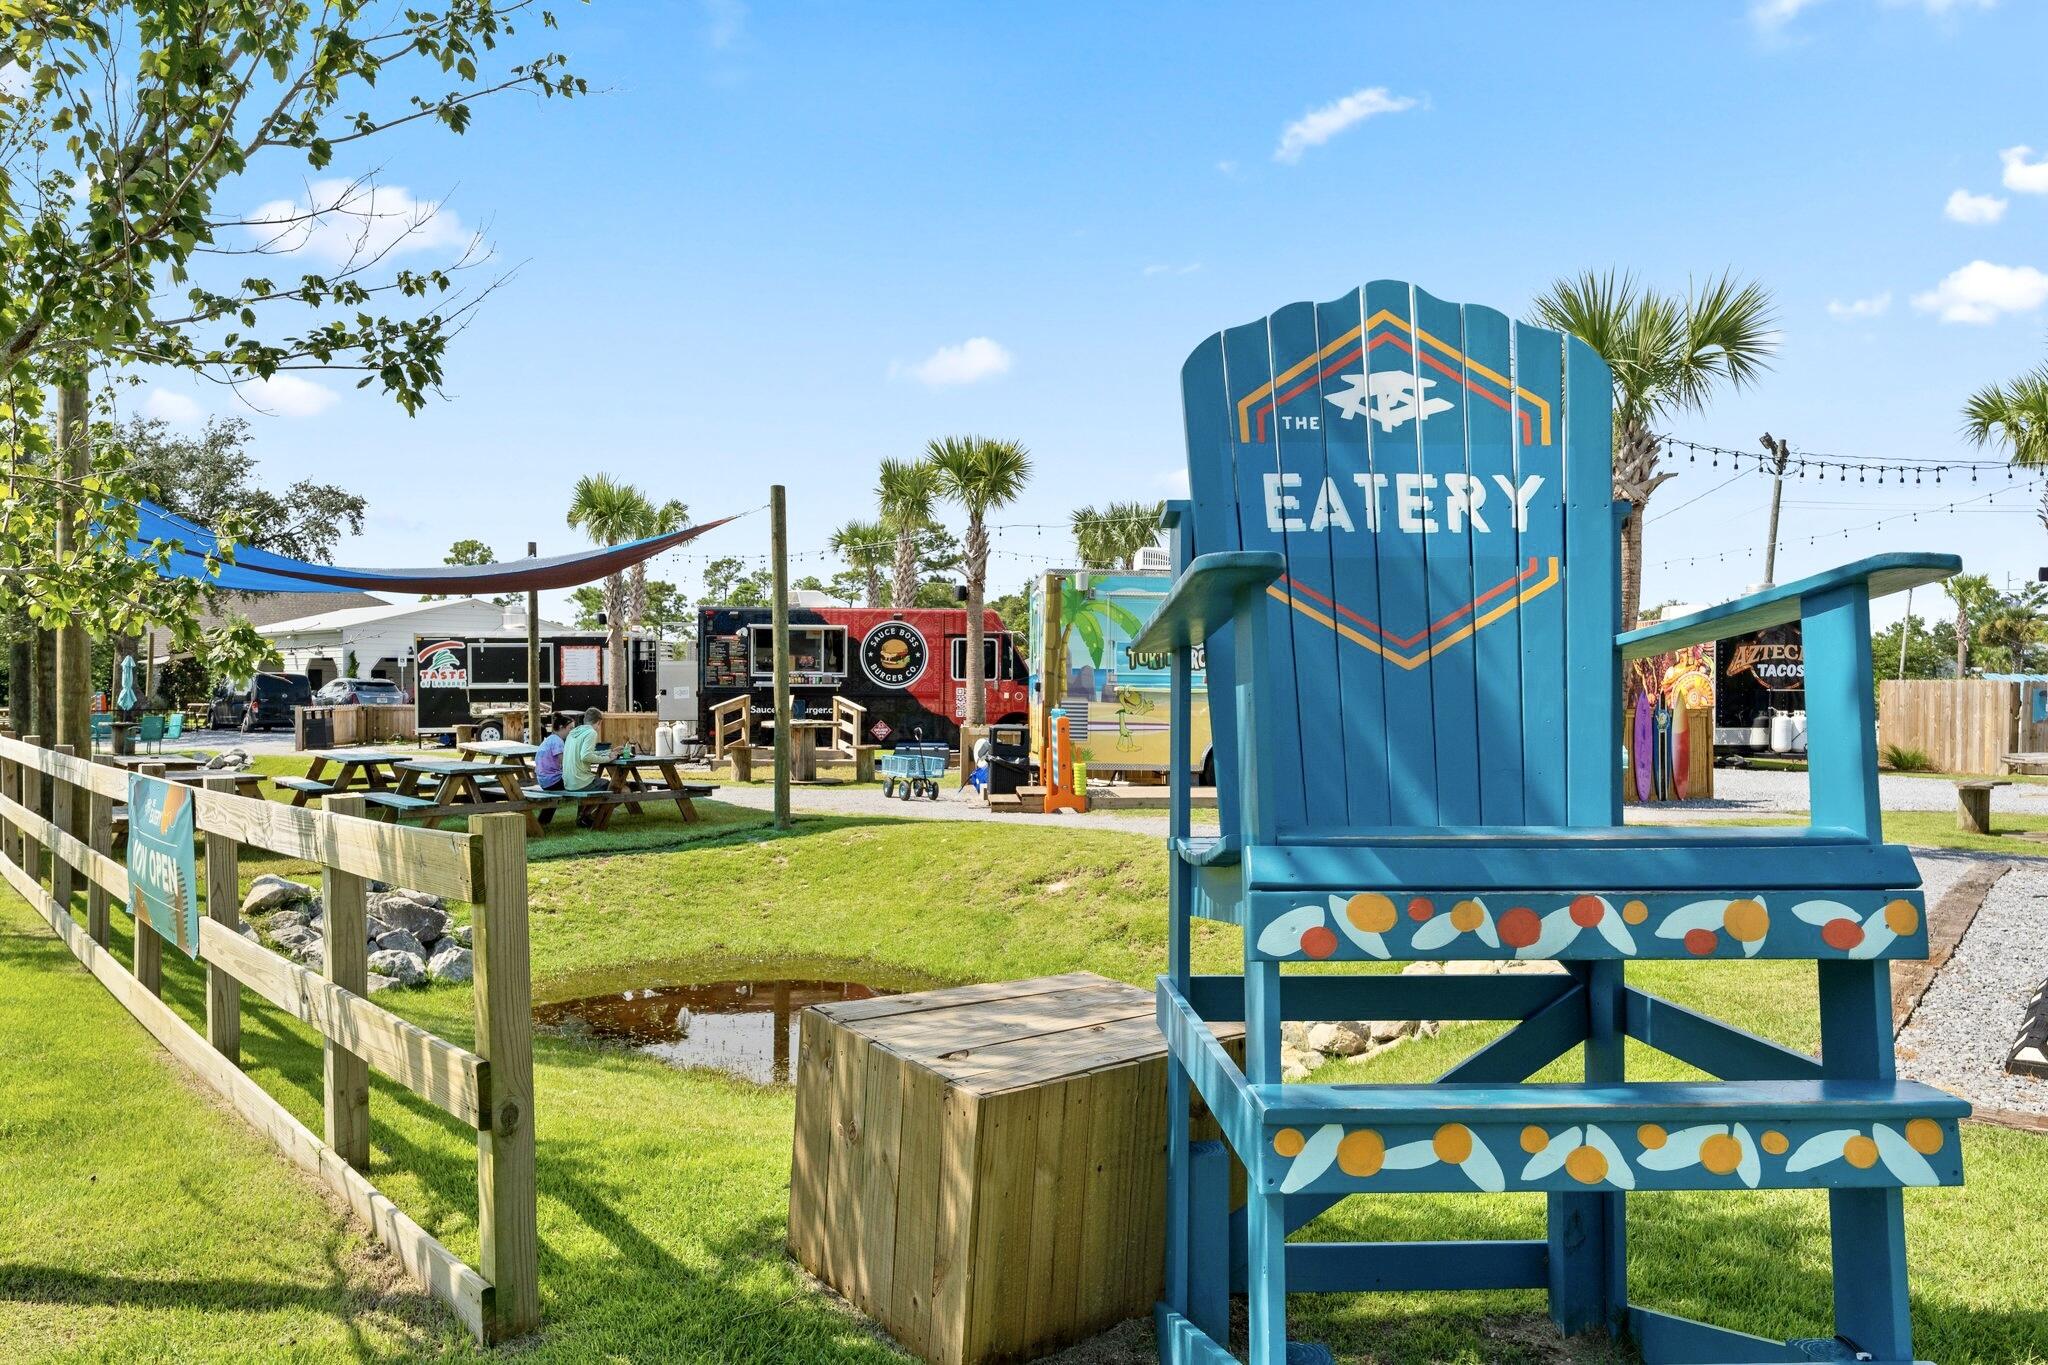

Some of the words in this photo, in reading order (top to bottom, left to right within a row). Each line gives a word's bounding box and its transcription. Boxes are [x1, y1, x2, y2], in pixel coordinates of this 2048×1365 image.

[1281, 416, 1320, 430] THE
[1262, 473, 1546, 534] EATERY
[870, 627, 896, 647] SAUCE
[899, 629, 919, 647] BOSS
[421, 671, 466, 680] TASTE
[870, 663, 903, 682] BURGER
[905, 665, 919, 677] CO.
[1757, 663, 1805, 677] TACOS
[149, 849, 179, 897] OPEN
